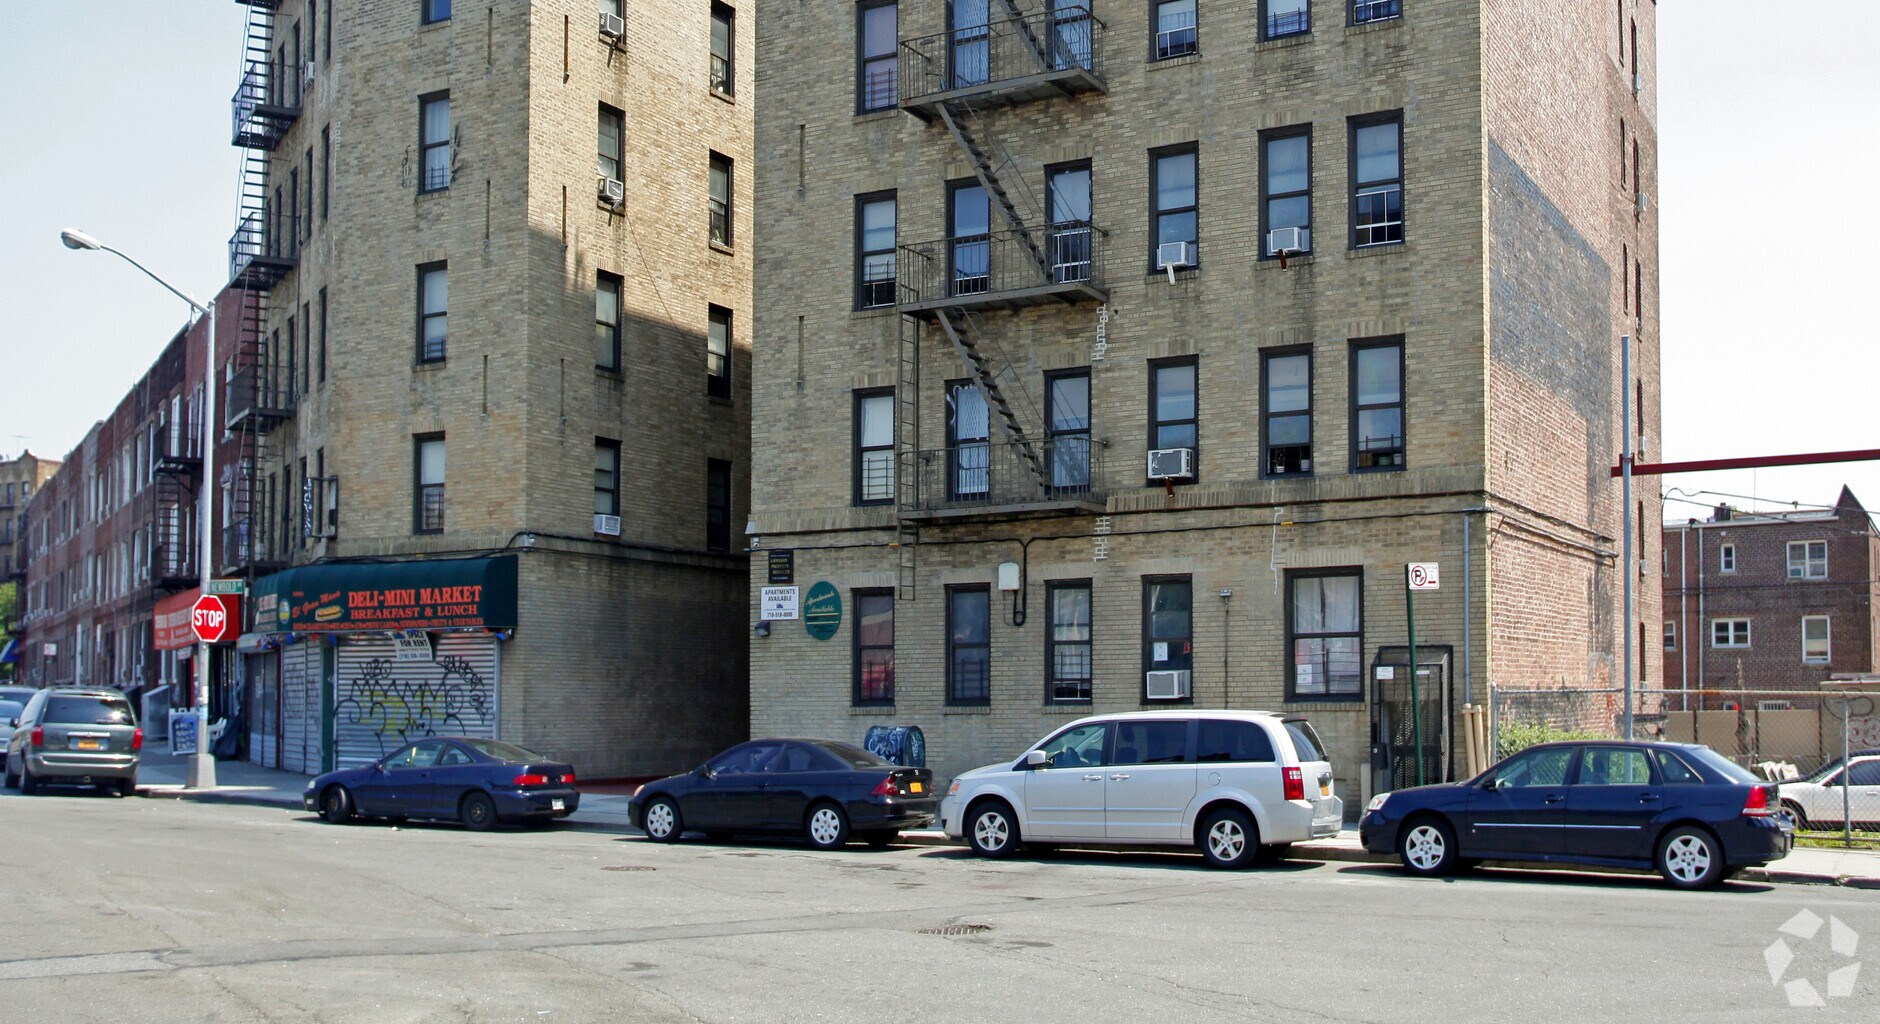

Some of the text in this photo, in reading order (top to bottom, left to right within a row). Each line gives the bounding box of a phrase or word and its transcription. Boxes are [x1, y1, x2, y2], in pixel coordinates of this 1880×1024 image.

[348, 588, 415, 607] DELI-MINI
[420, 585, 482, 604] MARKET
[195, 609, 223, 627] STOP
[351, 605, 477, 620] BREAKFAST & LUNCH
[408, 630, 424, 638] SPACE
[400, 639, 428, 647] FOR RENT
